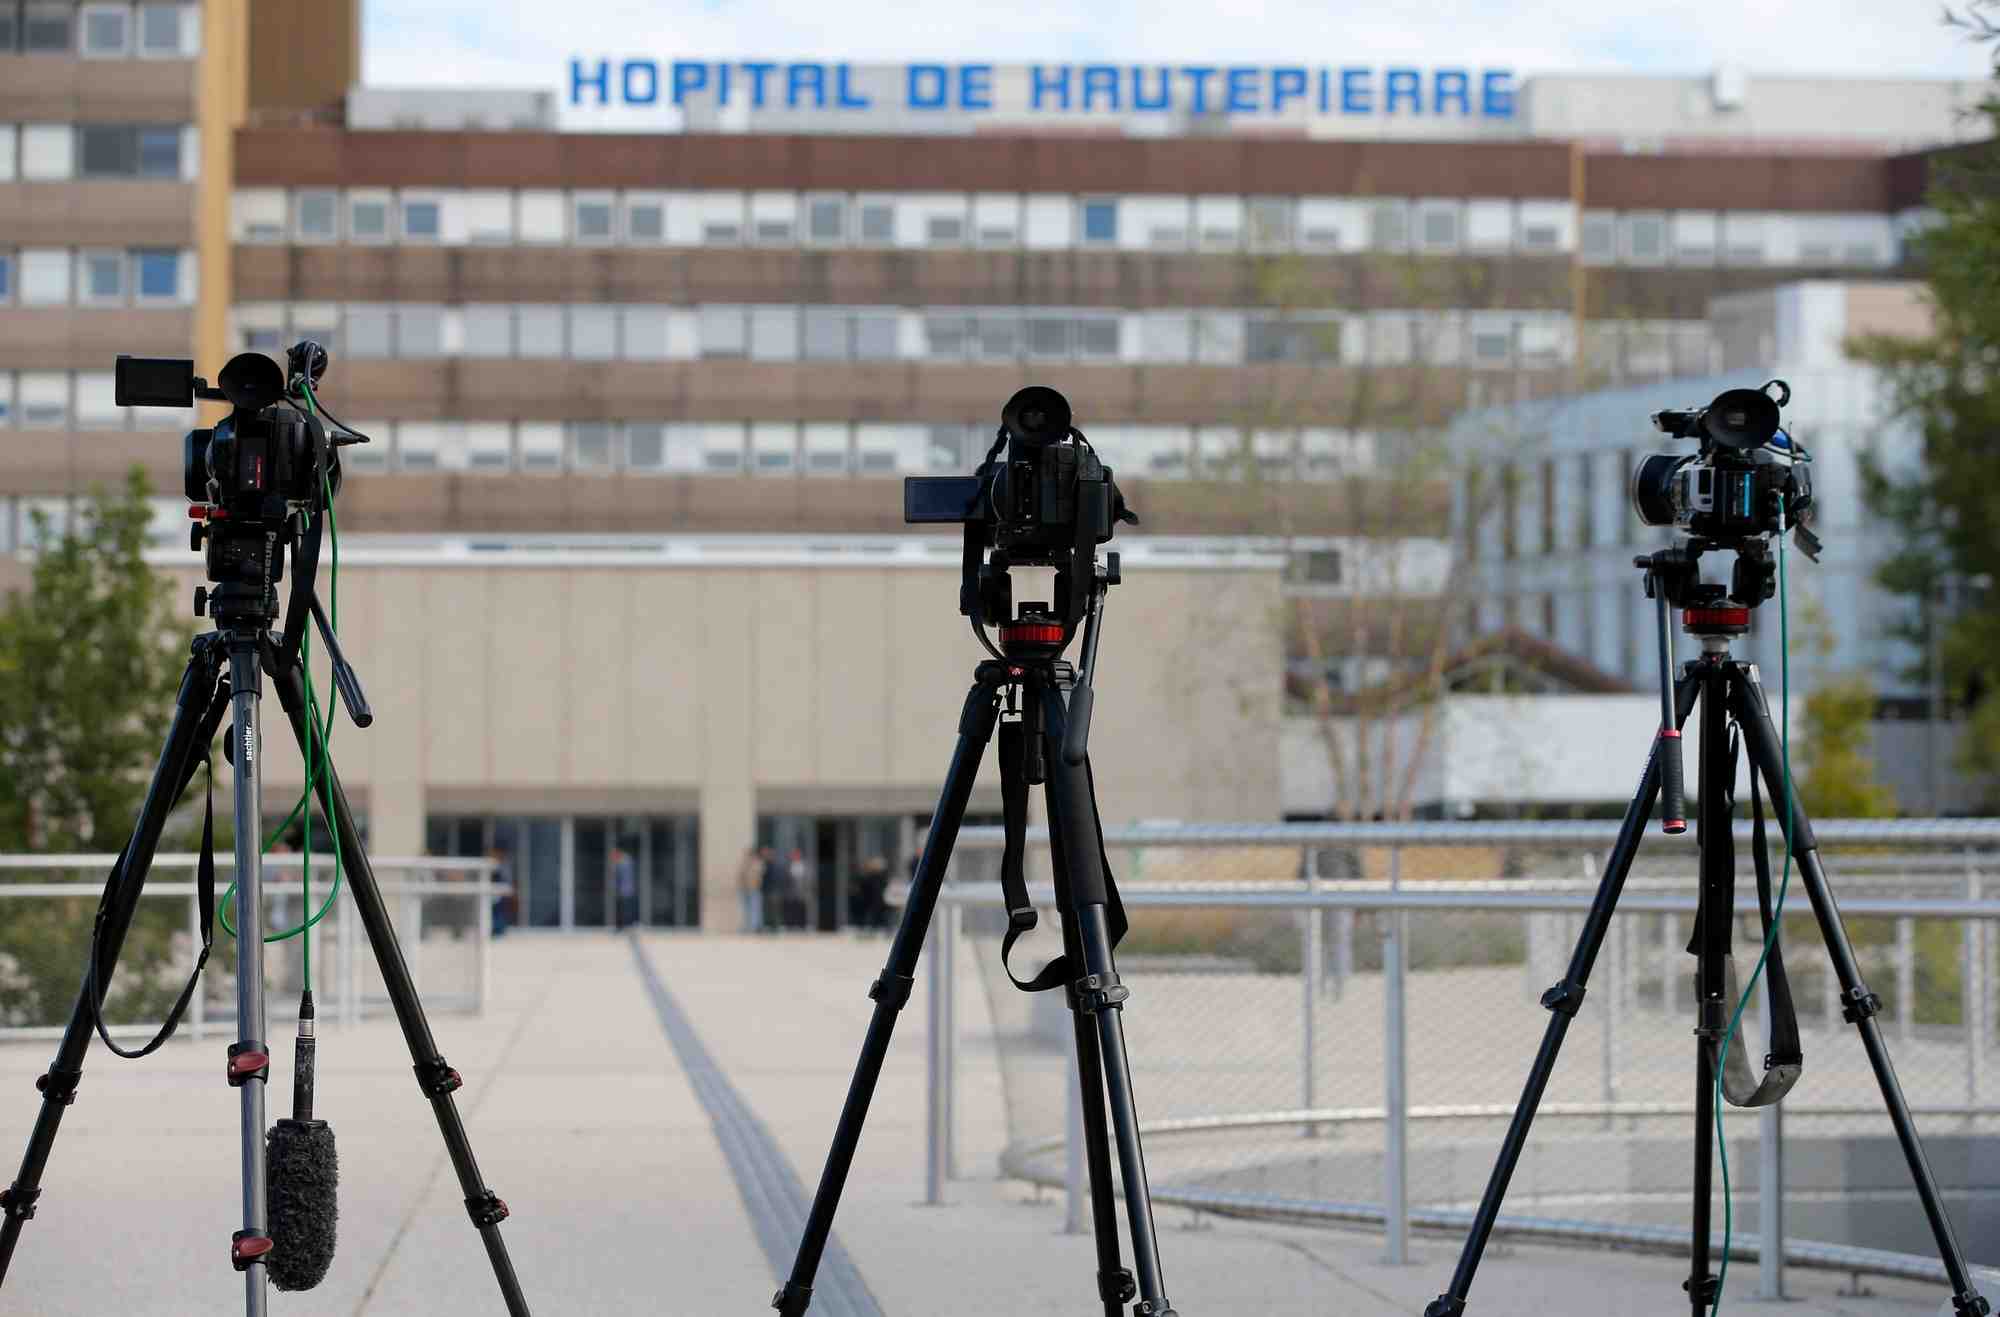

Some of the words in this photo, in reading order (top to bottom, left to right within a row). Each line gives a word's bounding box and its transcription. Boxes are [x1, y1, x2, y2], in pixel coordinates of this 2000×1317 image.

[571, 59, 871, 107] HOPITAL
[907, 62, 993, 109] DE
[1030, 63, 1516, 117] HAUTEPIERRE
[243, 721, 253, 761] sachtler
